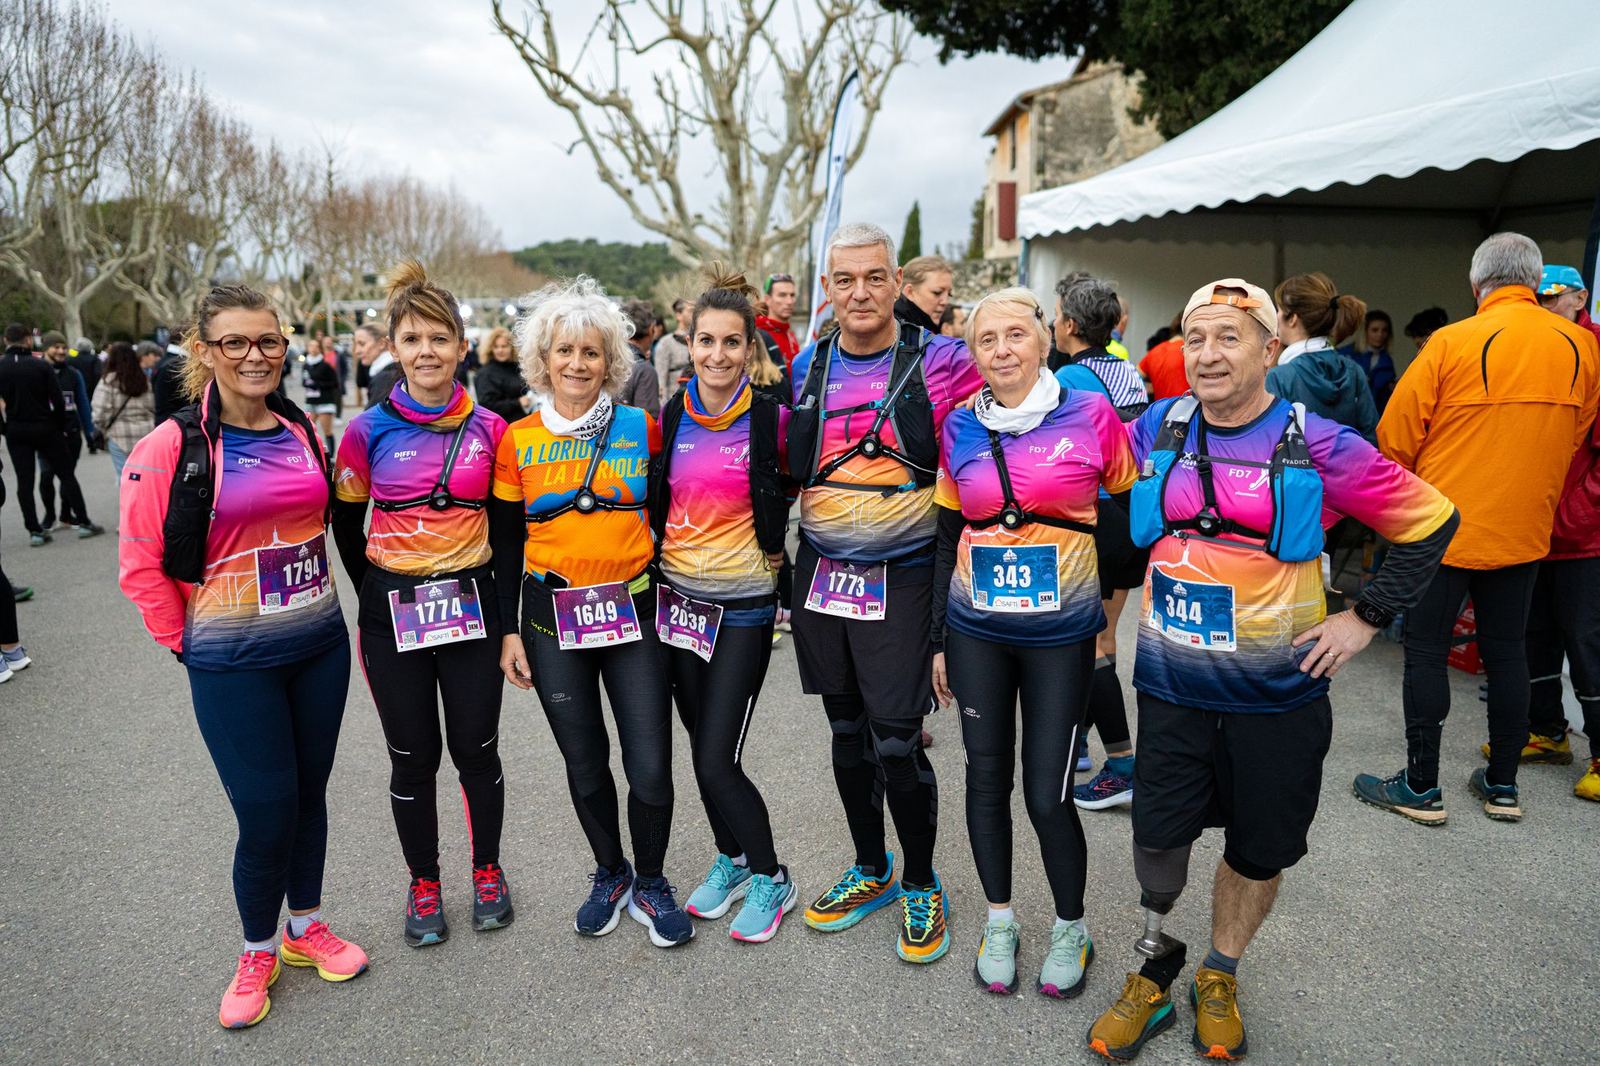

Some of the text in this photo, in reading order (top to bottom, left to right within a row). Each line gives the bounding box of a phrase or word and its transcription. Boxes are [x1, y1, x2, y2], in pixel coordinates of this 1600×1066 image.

[287, 455, 304, 464] FD7
[394, 450, 417, 458] DIFFU
[719, 445, 736, 456] FD7
[1029, 446, 1048, 454] FD7
[543, 456, 649, 487] LA LRIOLA
[1228, 468, 1252, 479] FD7
[283, 554, 321, 587] 1794
[993, 564, 1031, 588] 343
[828, 571, 865, 598] 1773
[1040, 594, 1053, 602] 5KM
[1165, 593, 1203, 625] 344
[415, 597, 463, 625] 1774
[573, 599, 617, 627] 1649
[669, 604, 707, 635] 2038
[1212, 634, 1227, 642] 5KM
